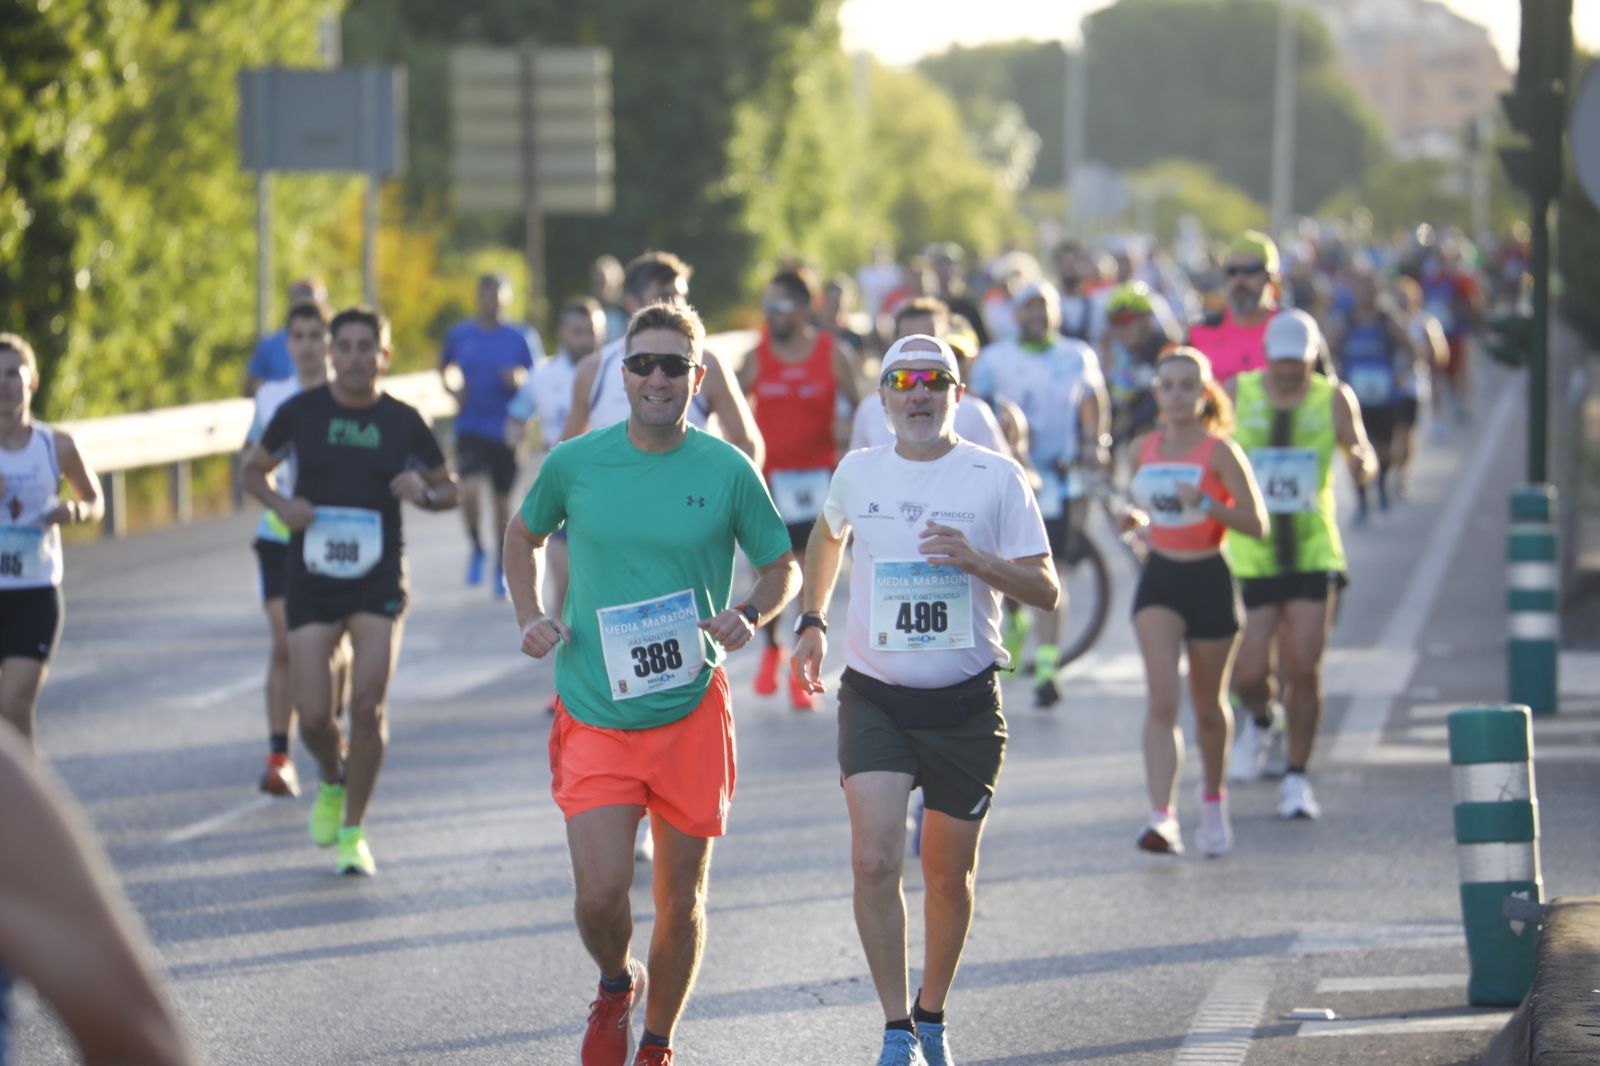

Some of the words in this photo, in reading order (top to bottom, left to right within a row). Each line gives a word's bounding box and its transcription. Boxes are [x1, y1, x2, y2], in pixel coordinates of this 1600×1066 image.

[940, 511, 976, 521] IMDECO
[878, 576, 909, 587] MEDIA
[896, 601, 948, 634] 496
[604, 622, 639, 637] MEDIA
[631, 638, 683, 678] 388
